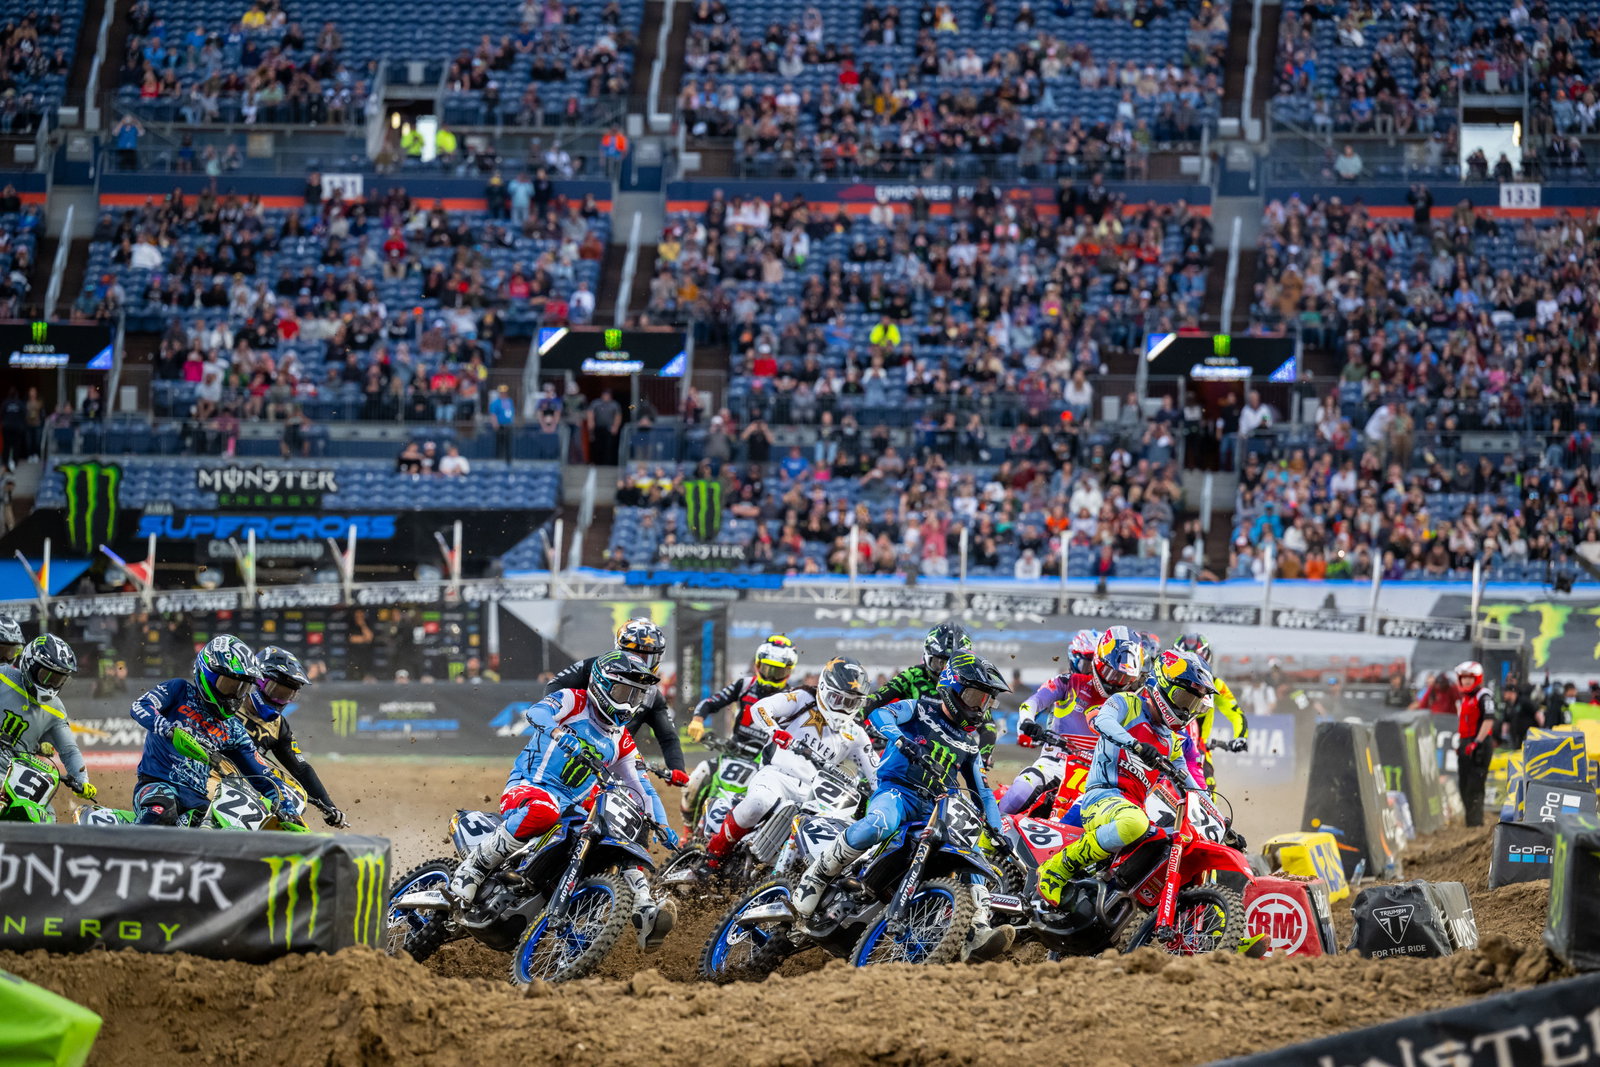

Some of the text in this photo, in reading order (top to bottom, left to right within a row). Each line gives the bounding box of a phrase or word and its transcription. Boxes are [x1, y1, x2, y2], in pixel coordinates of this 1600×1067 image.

[1504, 189, 1537, 203] 133
[198, 467, 338, 493] MONSTER
[219, 495, 317, 507] ENERGY
[137, 515, 398, 539] SUPERCROSS
[802, 733, 837, 761] SEVEN
[14, 769, 50, 805] 9
[720, 762, 754, 785] 81
[1118, 758, 1152, 791] HONDA
[216, 789, 263, 831] 22
[462, 812, 496, 838] 3
[559, 867, 577, 903] DUNLOP
[899, 870, 918, 907] DUNLOP
[1163, 882, 1174, 917] DUNLOP
[1379, 907, 1407, 918] TRIUMPH
[3, 914, 181, 942] NERGY
[1255, 912, 1296, 940] RM
[1371, 943, 1427, 959] FOR THE RIDE
